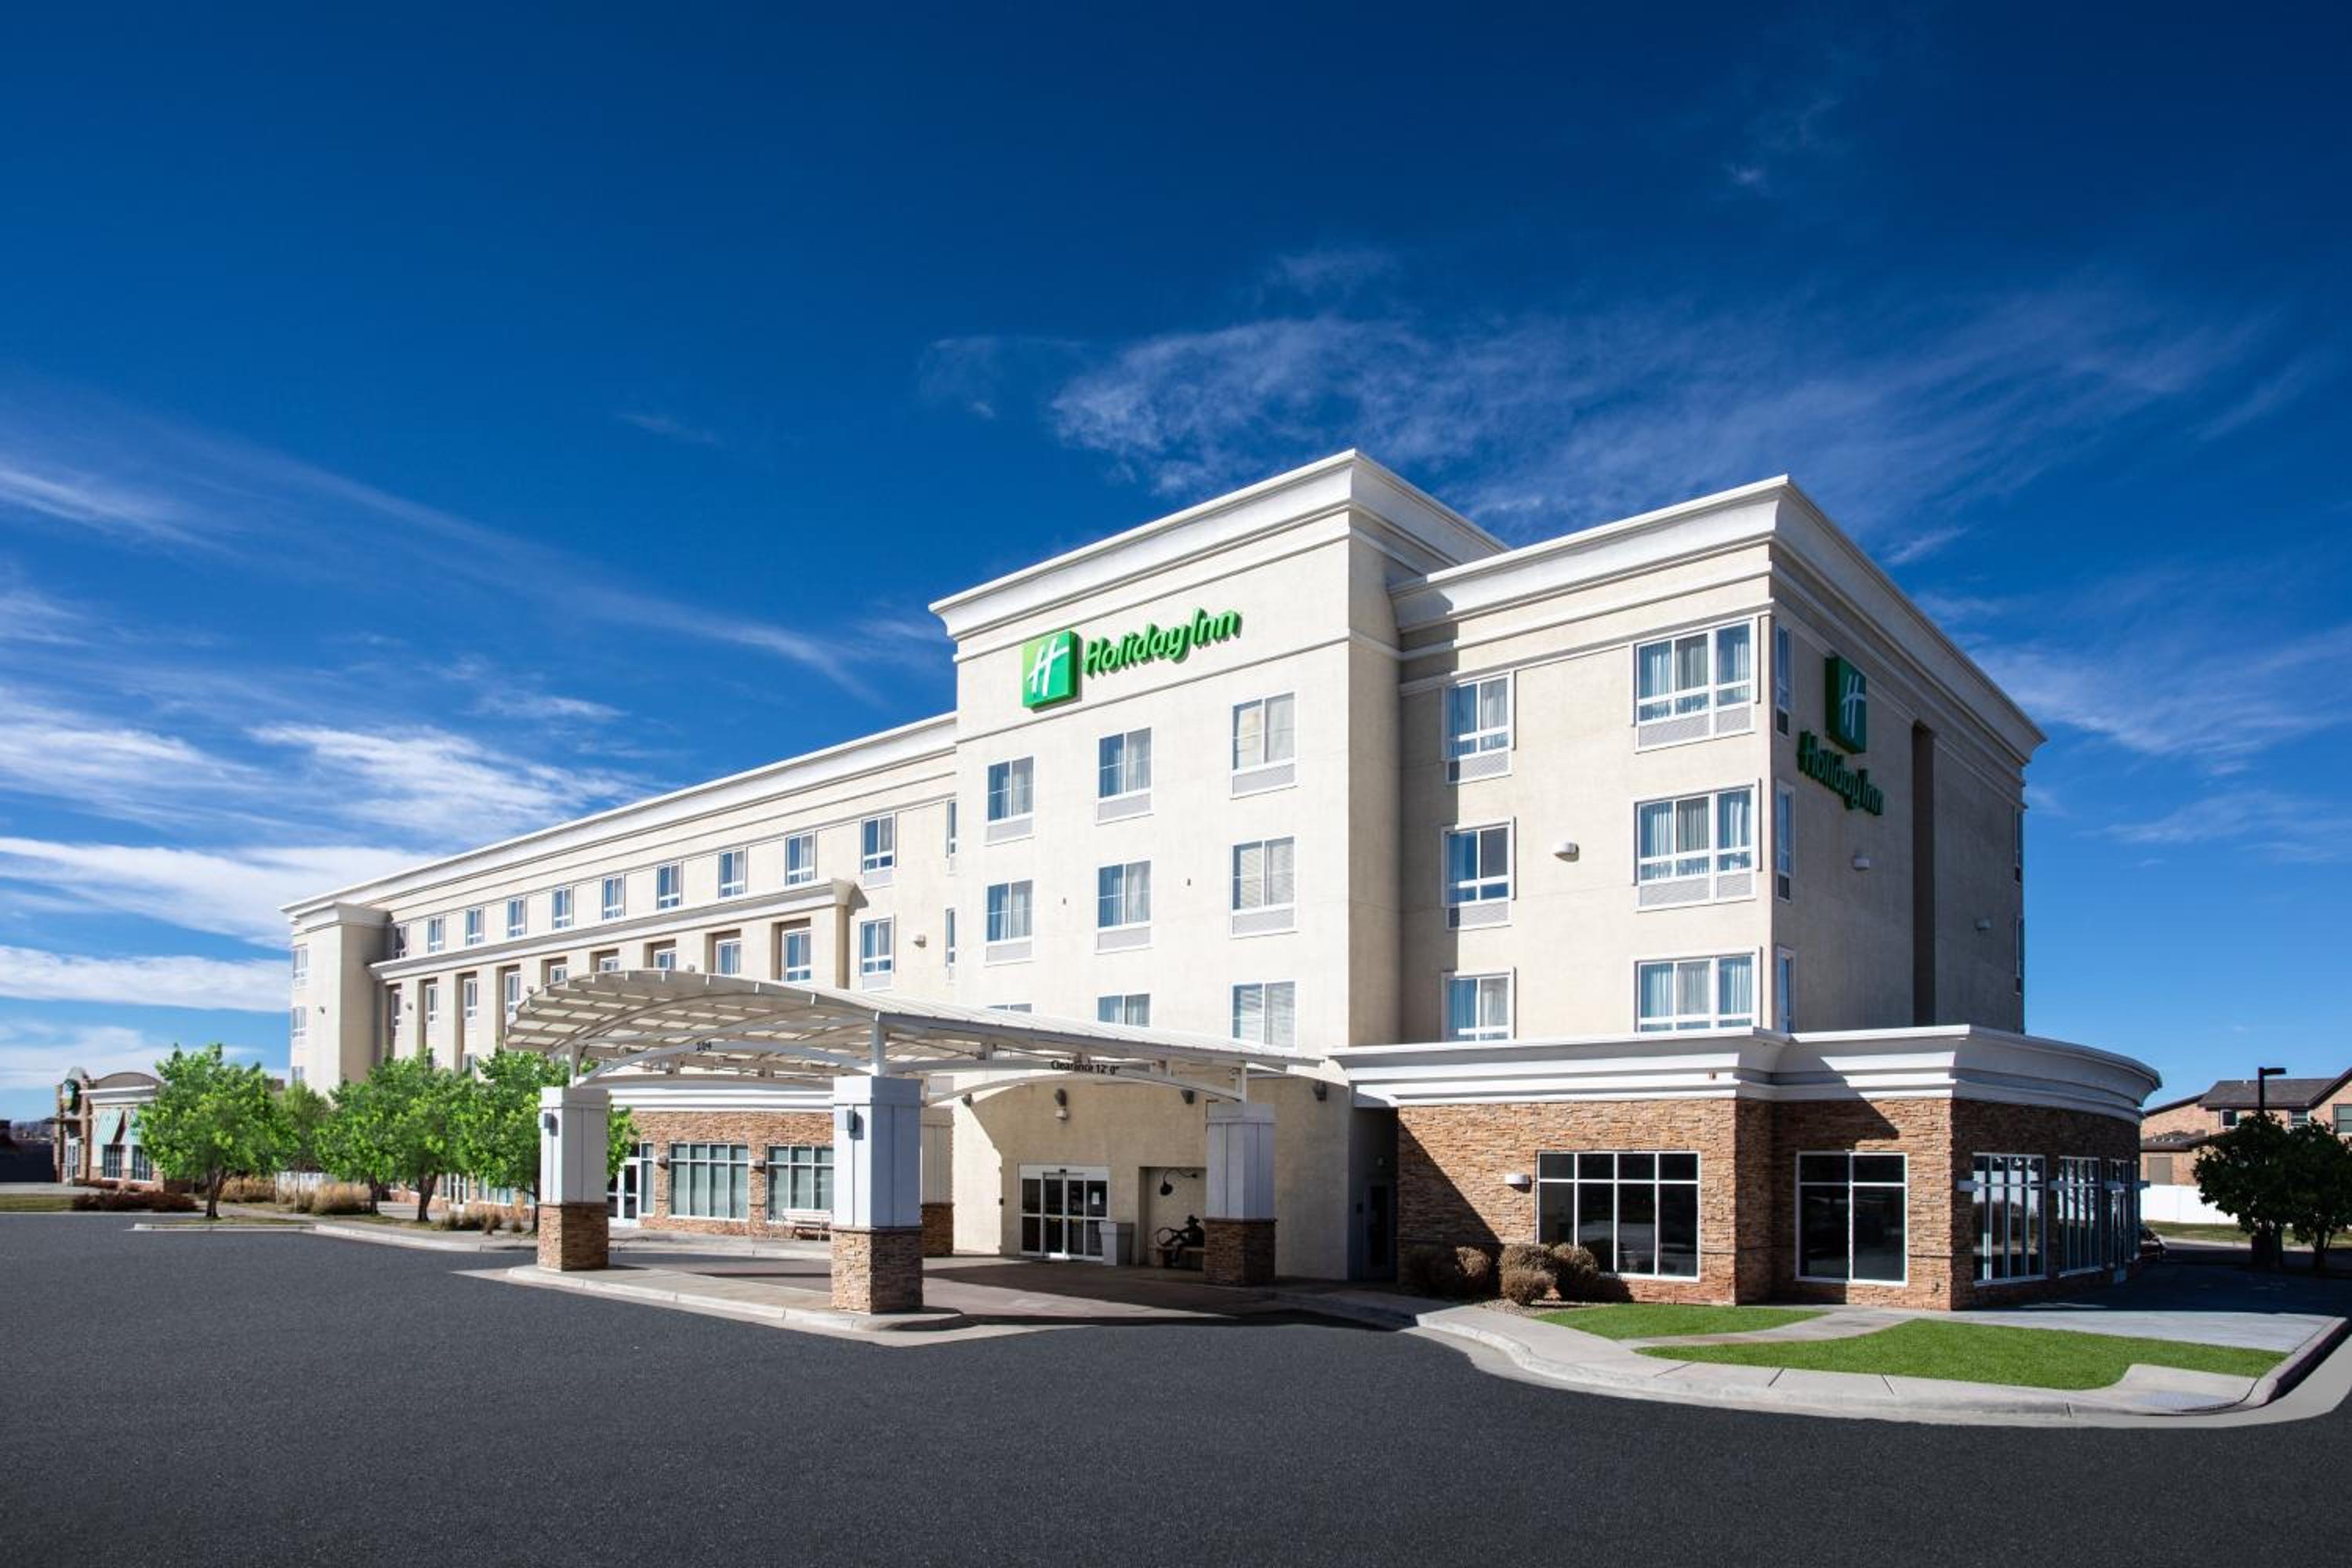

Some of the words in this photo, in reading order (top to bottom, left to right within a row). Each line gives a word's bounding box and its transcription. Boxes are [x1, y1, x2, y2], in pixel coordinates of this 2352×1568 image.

[1083, 623, 1190, 677] Holiday
[1191, 608, 1241, 646] Inn
[1798, 731, 1859, 811] Holiday
[1857, 769, 1883, 816] Inn
[1051, 1060, 1094, 1073] Clearance
